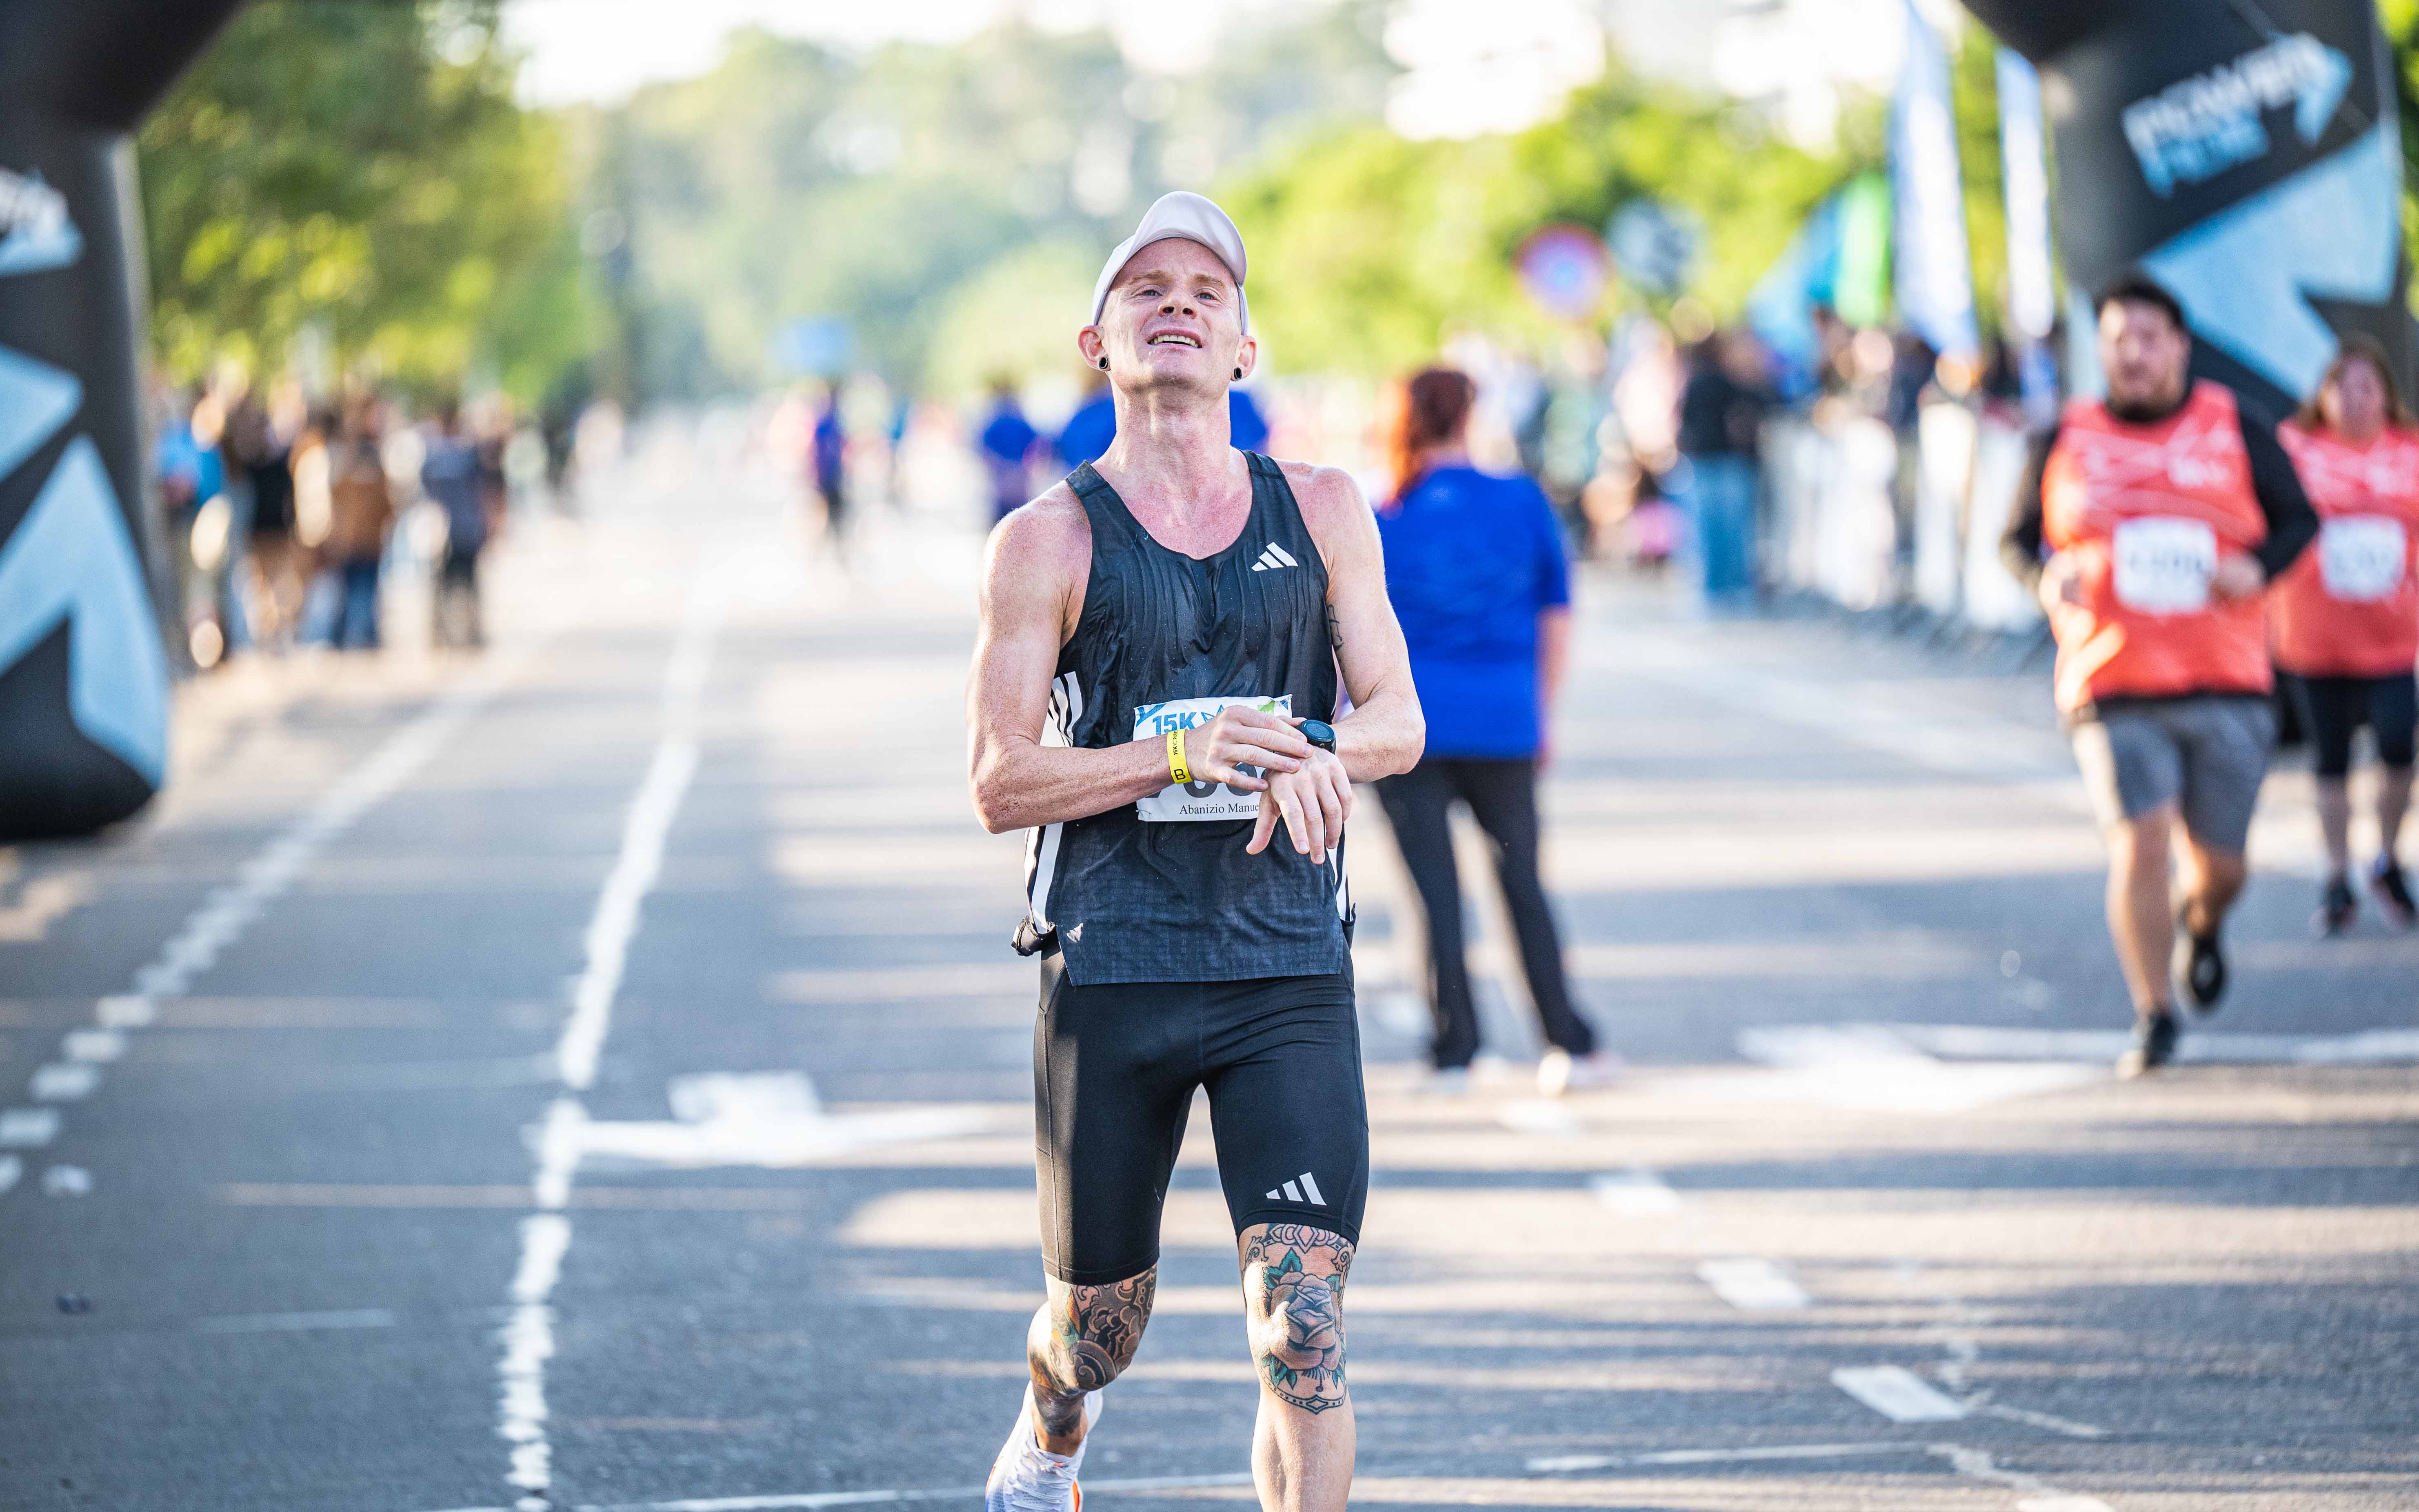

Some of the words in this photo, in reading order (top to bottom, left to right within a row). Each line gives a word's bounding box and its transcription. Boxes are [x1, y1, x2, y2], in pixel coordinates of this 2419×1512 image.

[1153, 712, 1197, 735] 15K
[1174, 768, 1186, 780] B
[1180, 804, 1224, 814] Abanizio
